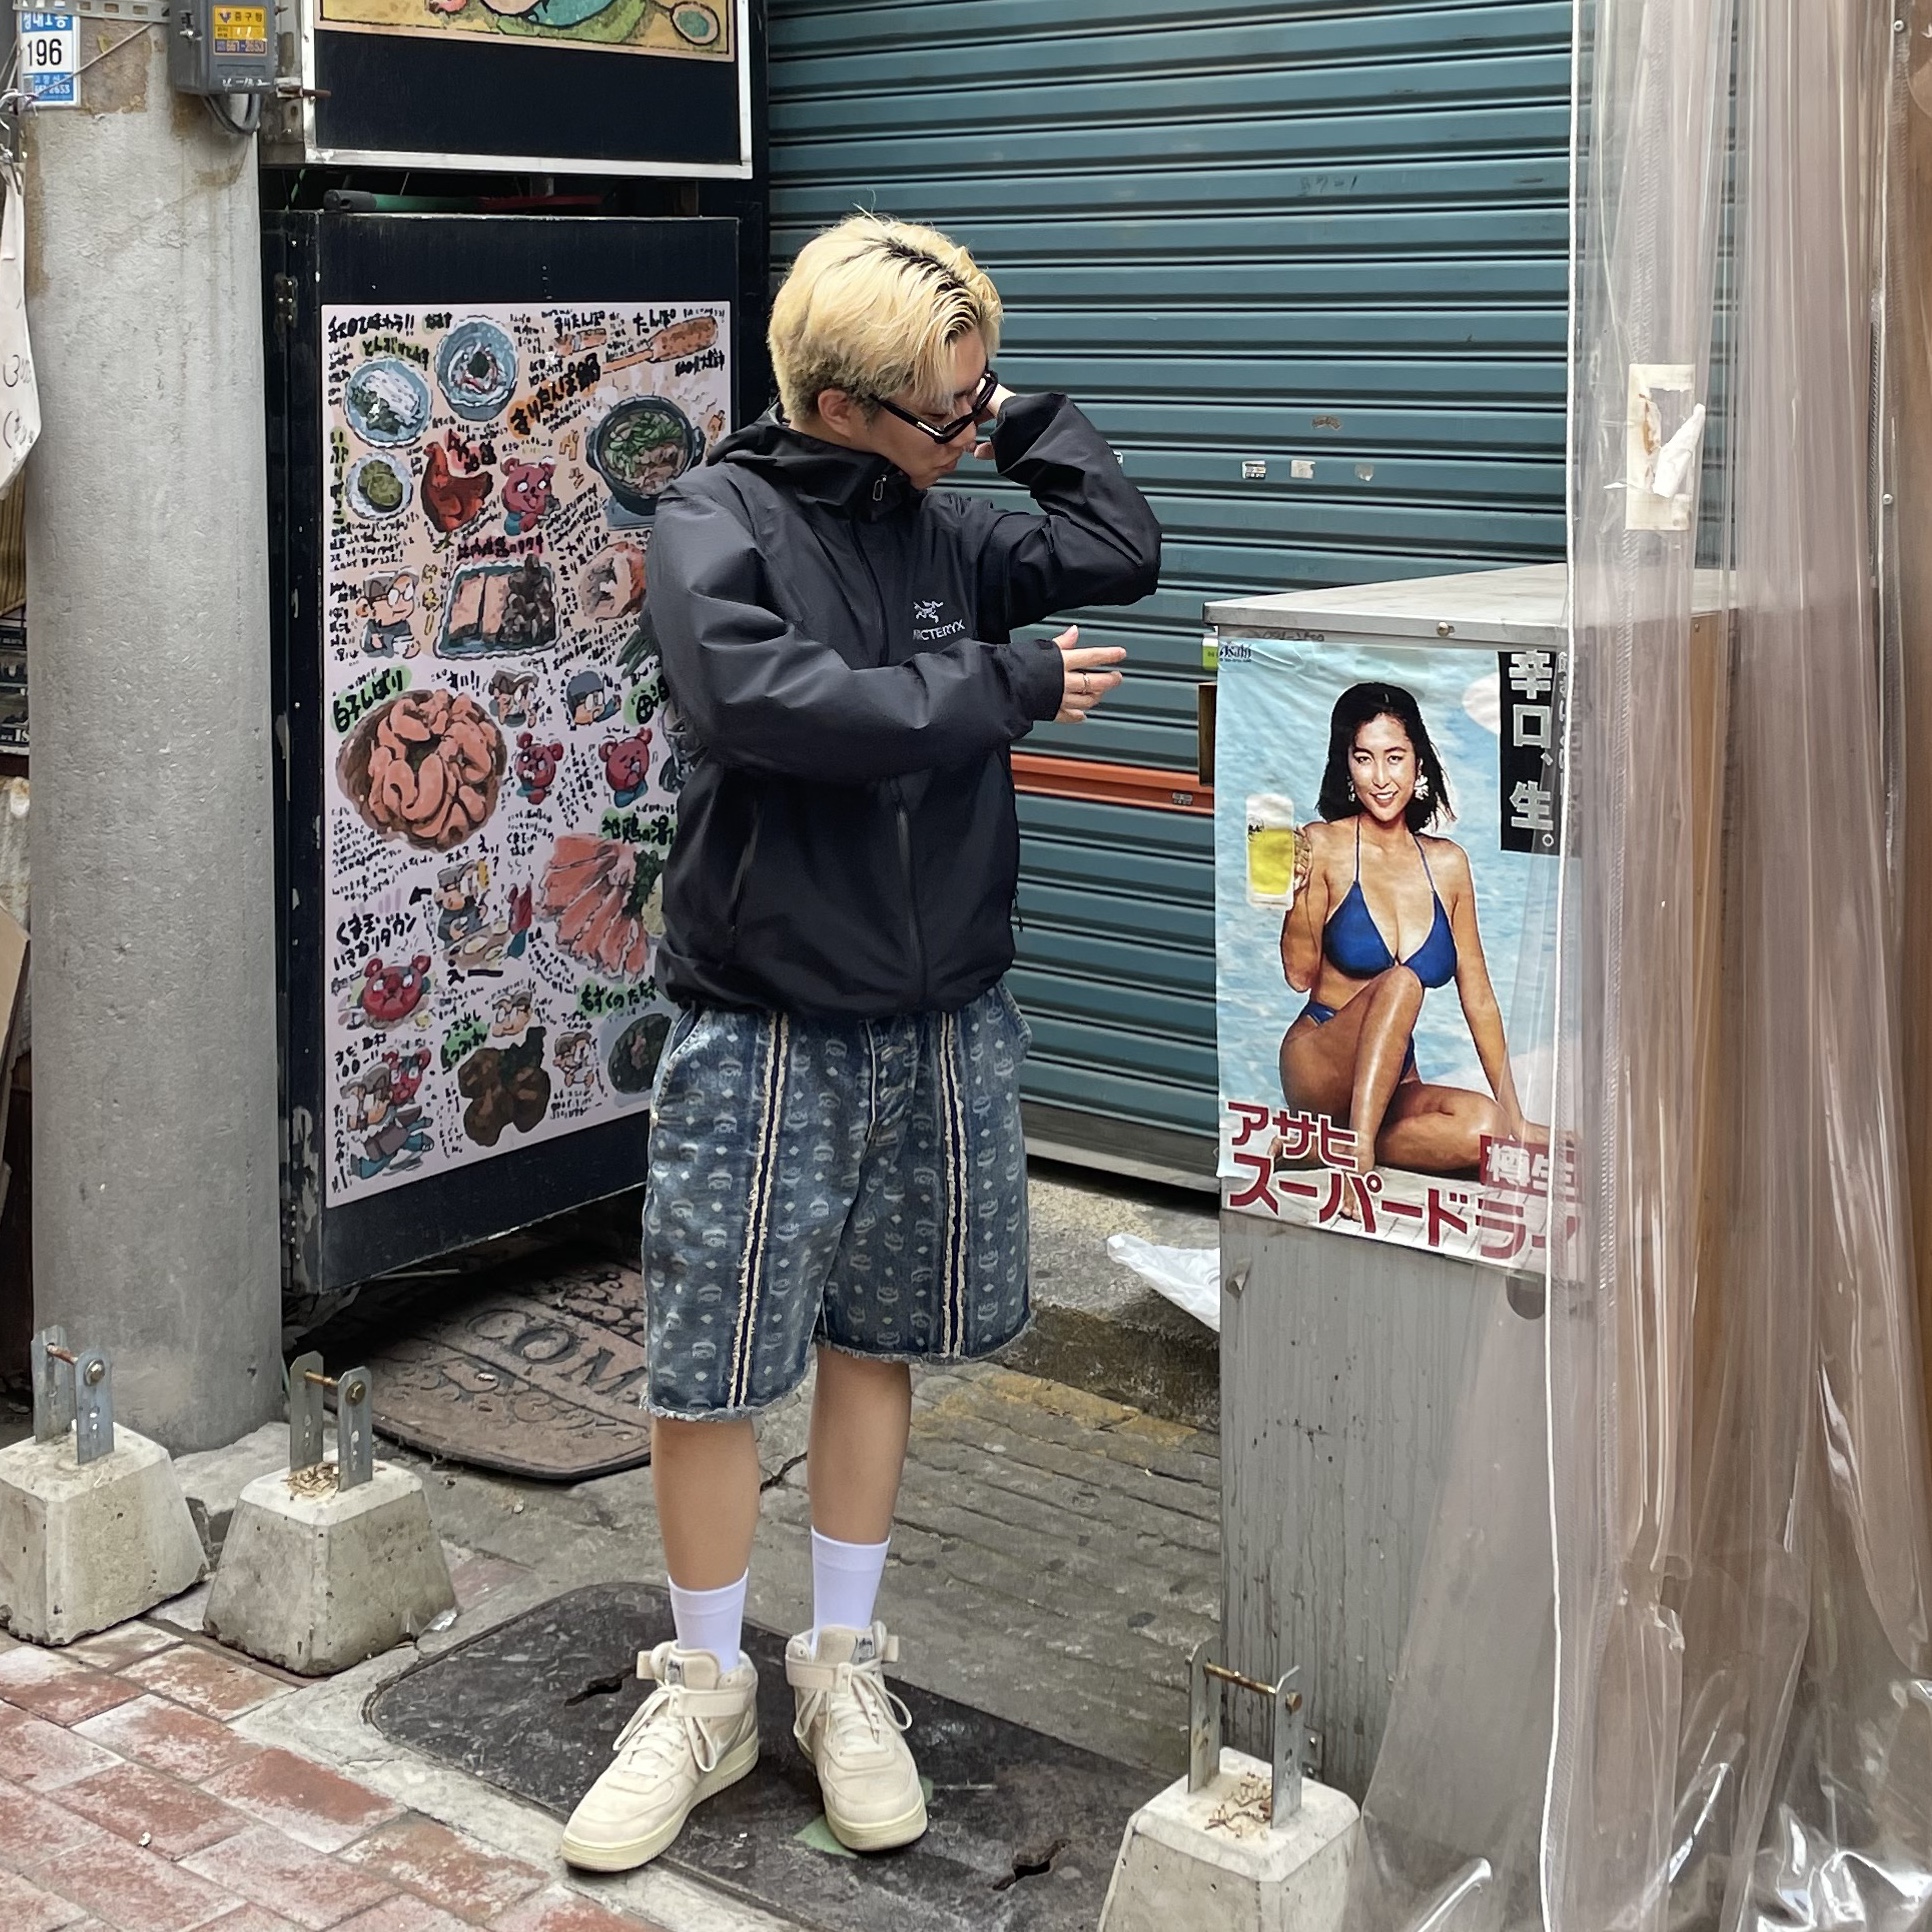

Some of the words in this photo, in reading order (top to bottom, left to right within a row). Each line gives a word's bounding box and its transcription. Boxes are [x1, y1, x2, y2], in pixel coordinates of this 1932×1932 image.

[27, 38, 62, 67] 196
[1508, 650, 1555, 848] 辛口、生。
[1227, 1101, 1358, 1171] アサヒ
